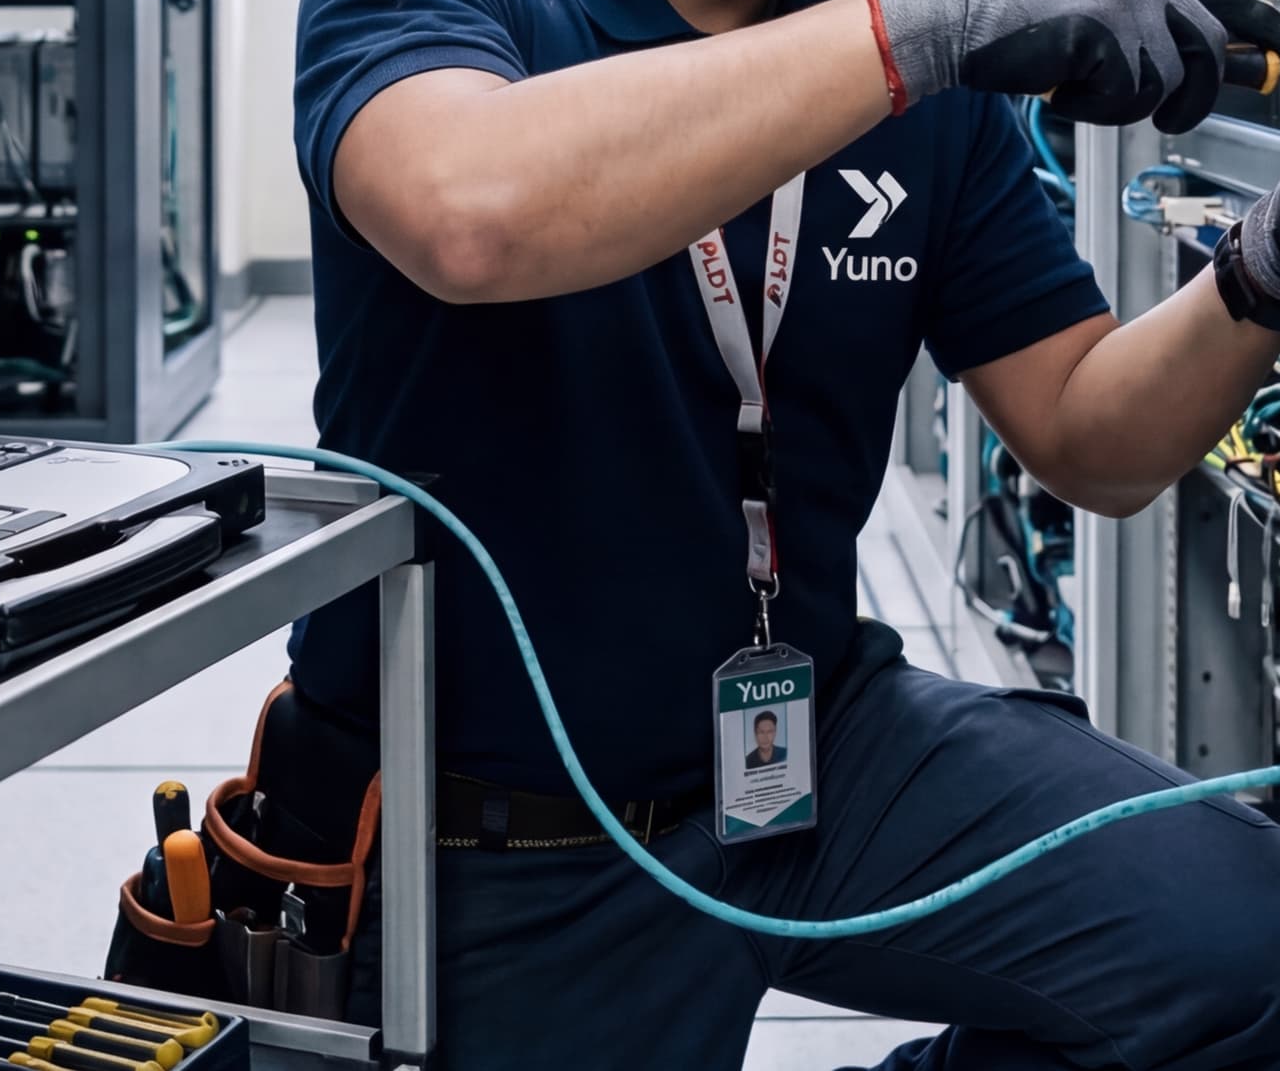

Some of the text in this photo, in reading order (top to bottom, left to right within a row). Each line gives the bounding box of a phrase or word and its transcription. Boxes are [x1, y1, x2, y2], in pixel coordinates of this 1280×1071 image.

[697, 240, 736, 306] PLDT
[821, 245, 918, 282] Yuno
[736, 678, 796, 704] Yuno
